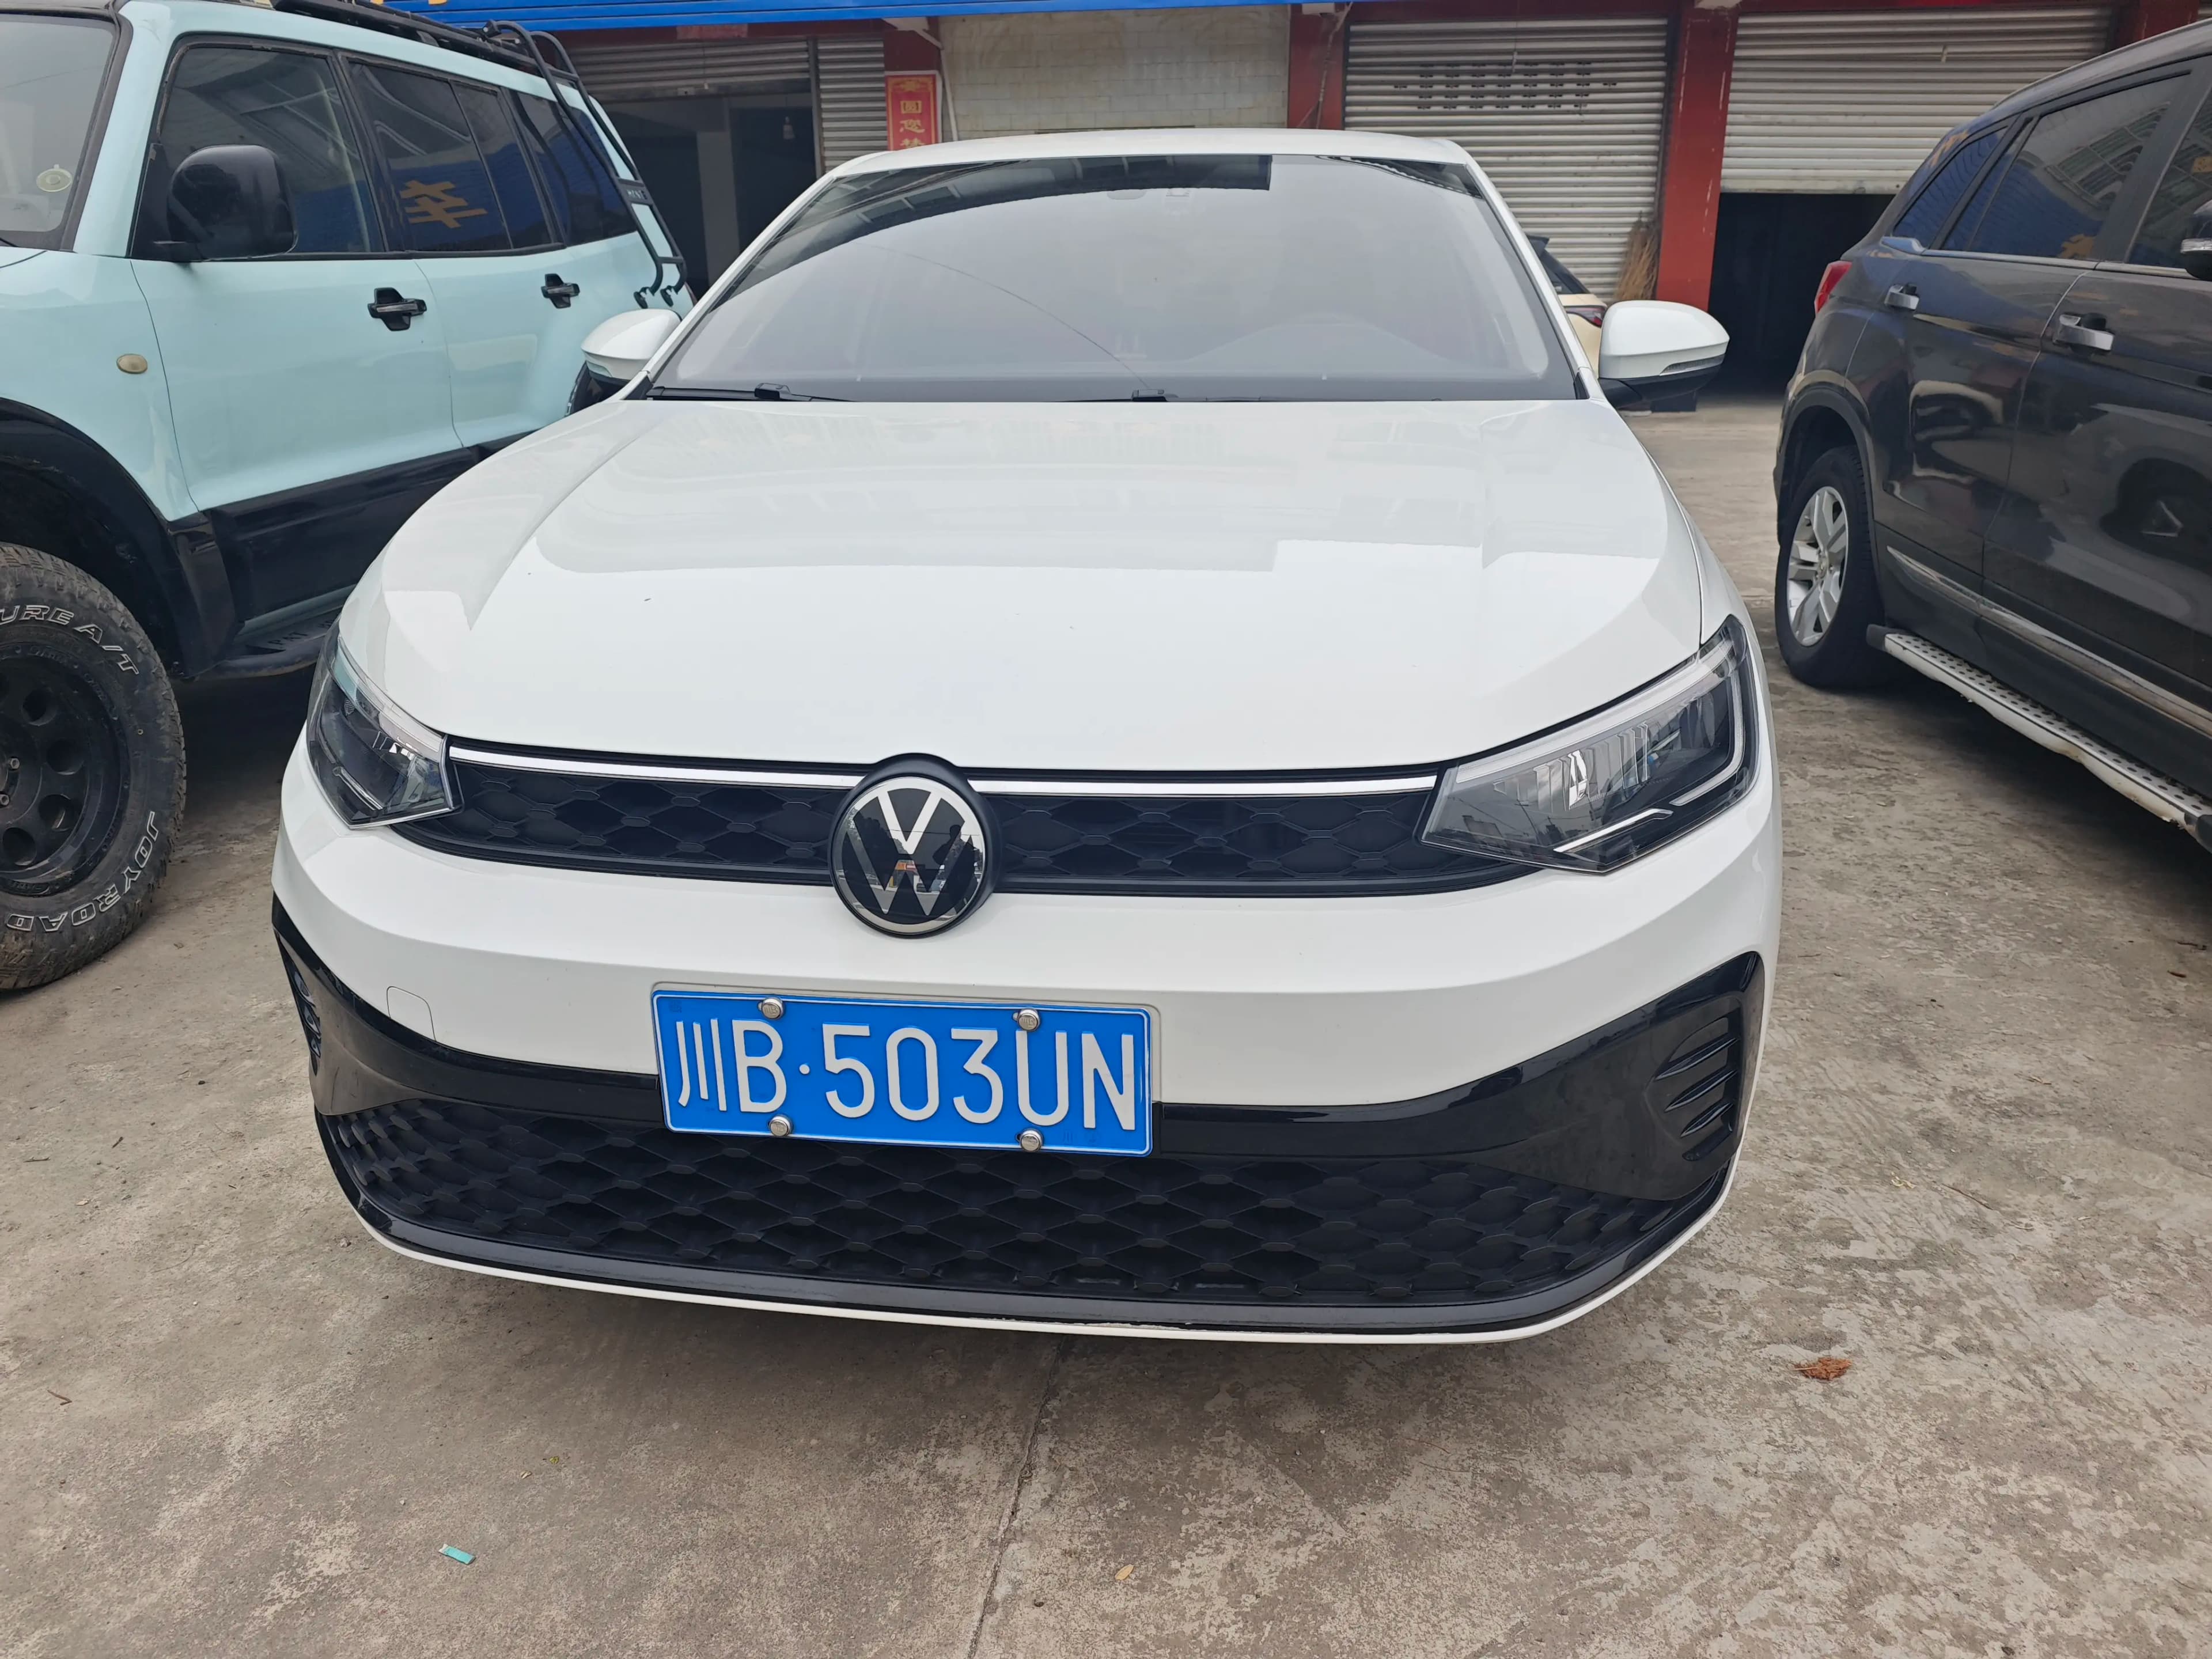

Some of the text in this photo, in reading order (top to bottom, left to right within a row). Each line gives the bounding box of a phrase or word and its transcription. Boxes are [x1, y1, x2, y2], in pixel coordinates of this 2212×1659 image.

[72, 624, 139, 675] A/T
[6, 811, 159, 932] JOYROAD
[676, 1018, 1136, 1131] 川B·503UN
